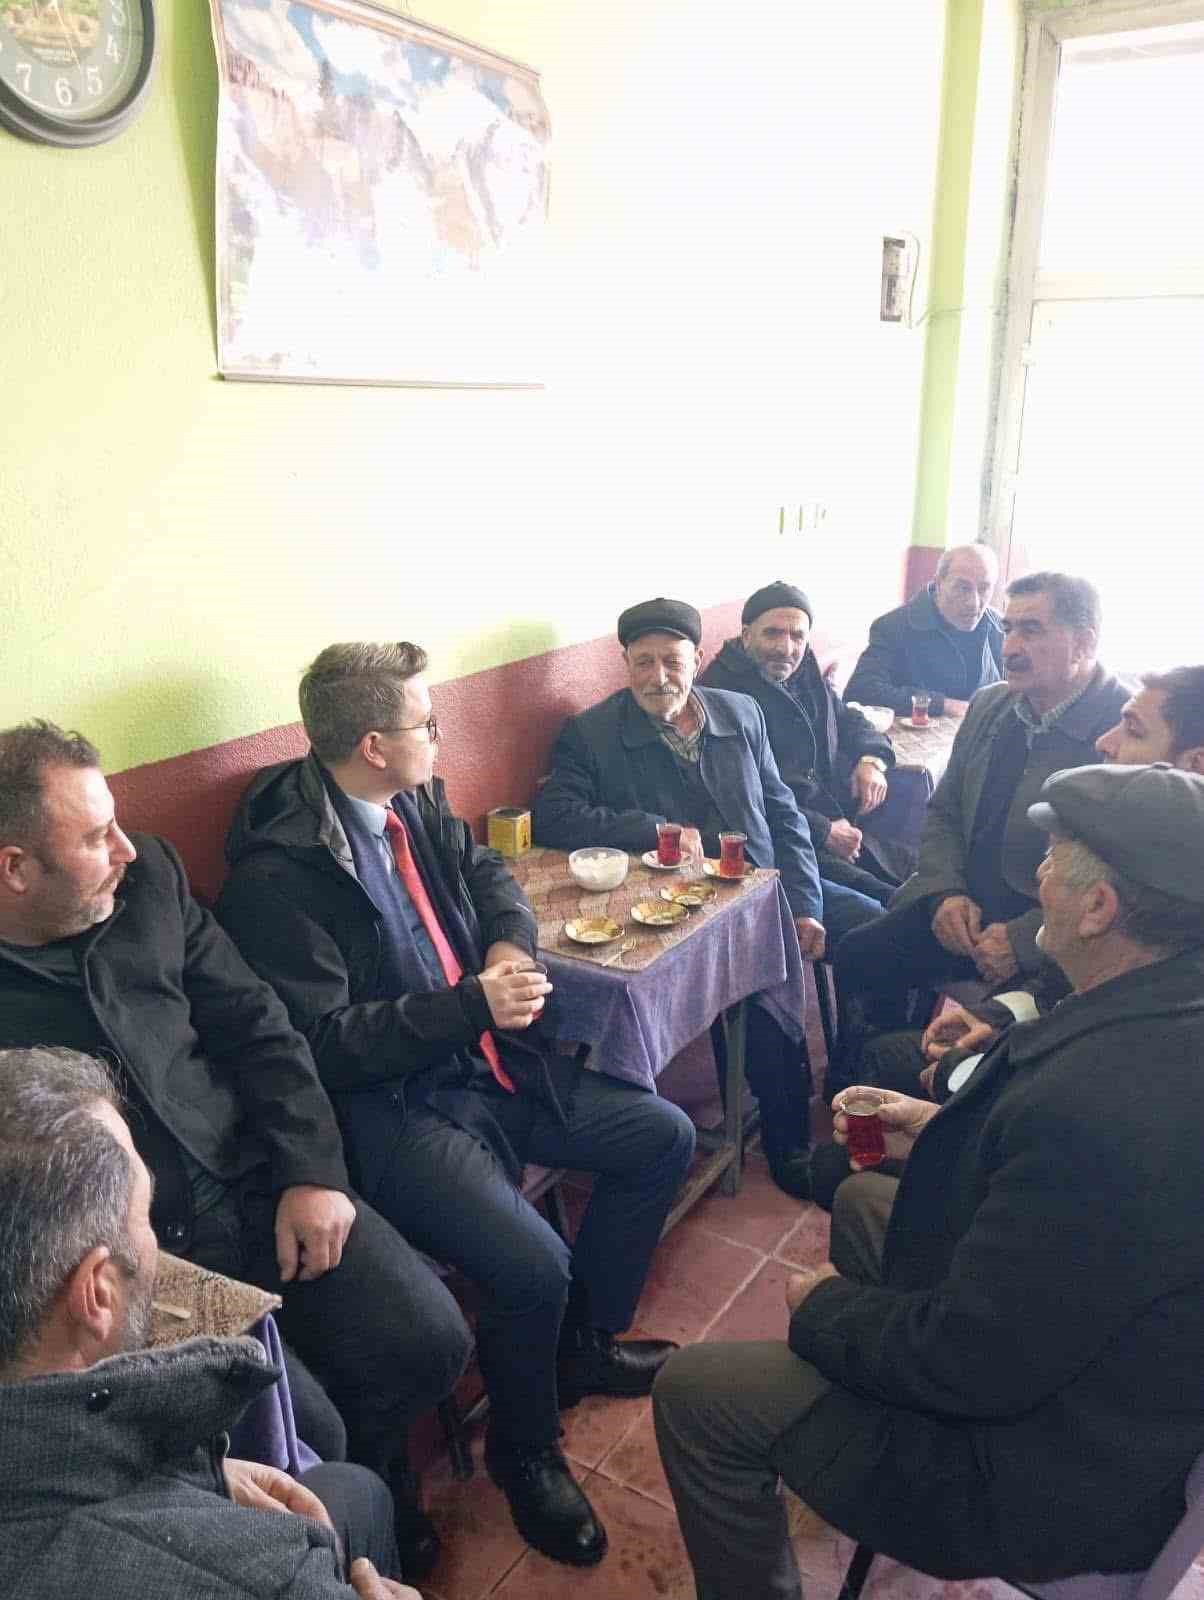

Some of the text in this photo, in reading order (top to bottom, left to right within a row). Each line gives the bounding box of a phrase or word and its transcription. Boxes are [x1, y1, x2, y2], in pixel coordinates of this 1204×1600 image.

[105, 33, 120, 63] 4
[16, 63, 32, 93] 7
[55, 77, 73, 107] 6
[87, 65, 103, 96] 5
